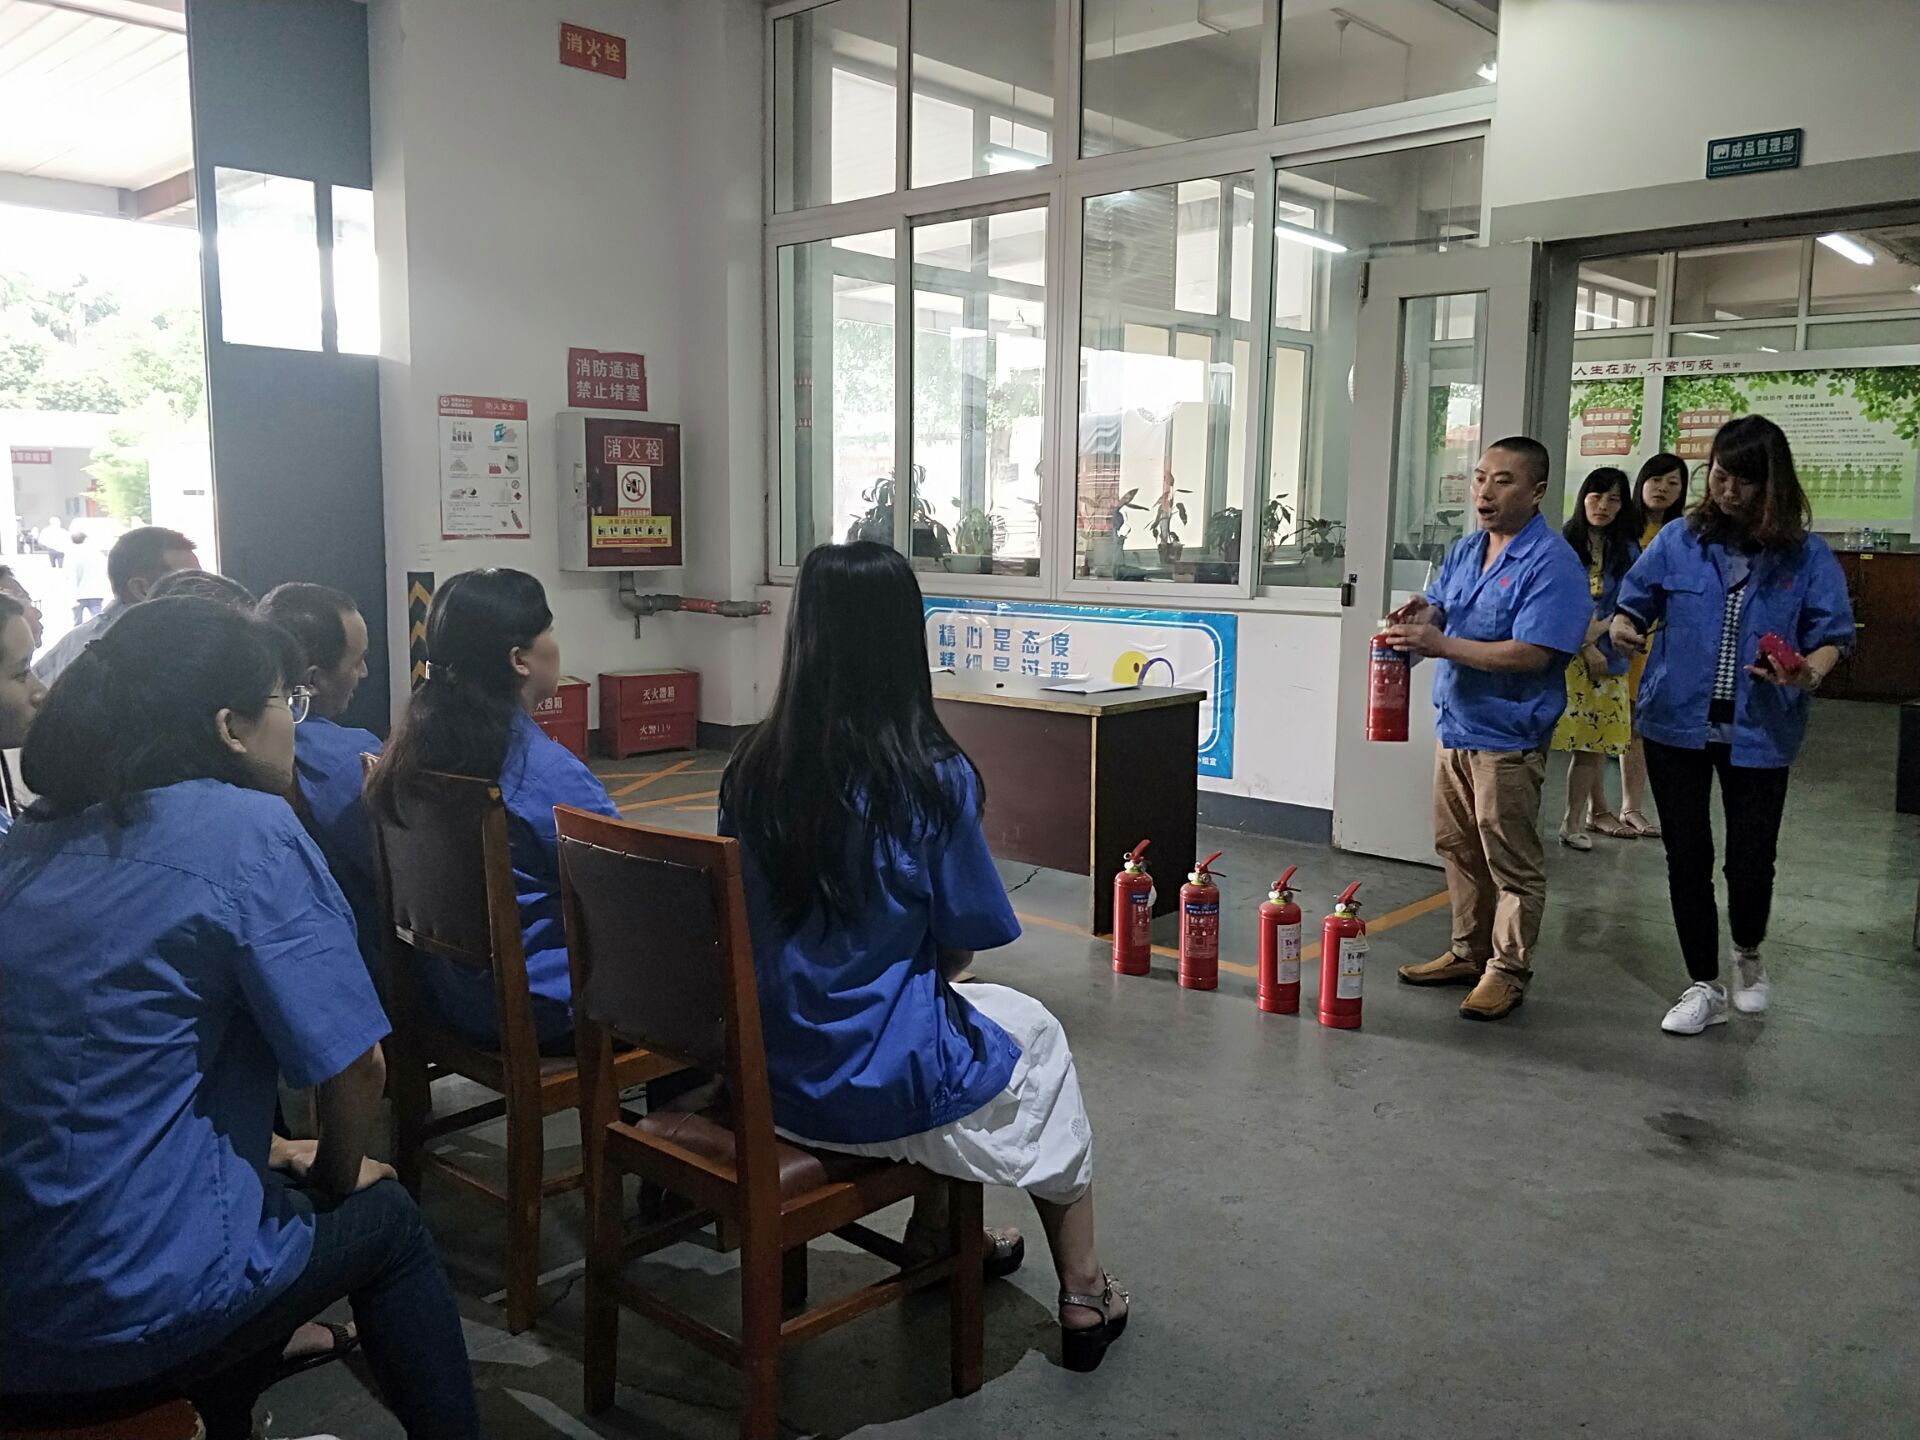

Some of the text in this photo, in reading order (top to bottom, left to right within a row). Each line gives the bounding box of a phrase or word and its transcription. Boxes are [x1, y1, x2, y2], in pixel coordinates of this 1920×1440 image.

[566, 31, 621, 63] 消火栓
[1730, 135, 1795, 159] 成品管理部
[575, 358, 641, 380] 消防通道
[576, 380, 641, 402] 禁止堵塞
[607, 438, 660, 460] 消火栓
[939, 624, 1070, 658] 精心是态度
[535, 696, 563, 711] 火器箱
[642, 685, 675, 701] 灭火器箱
